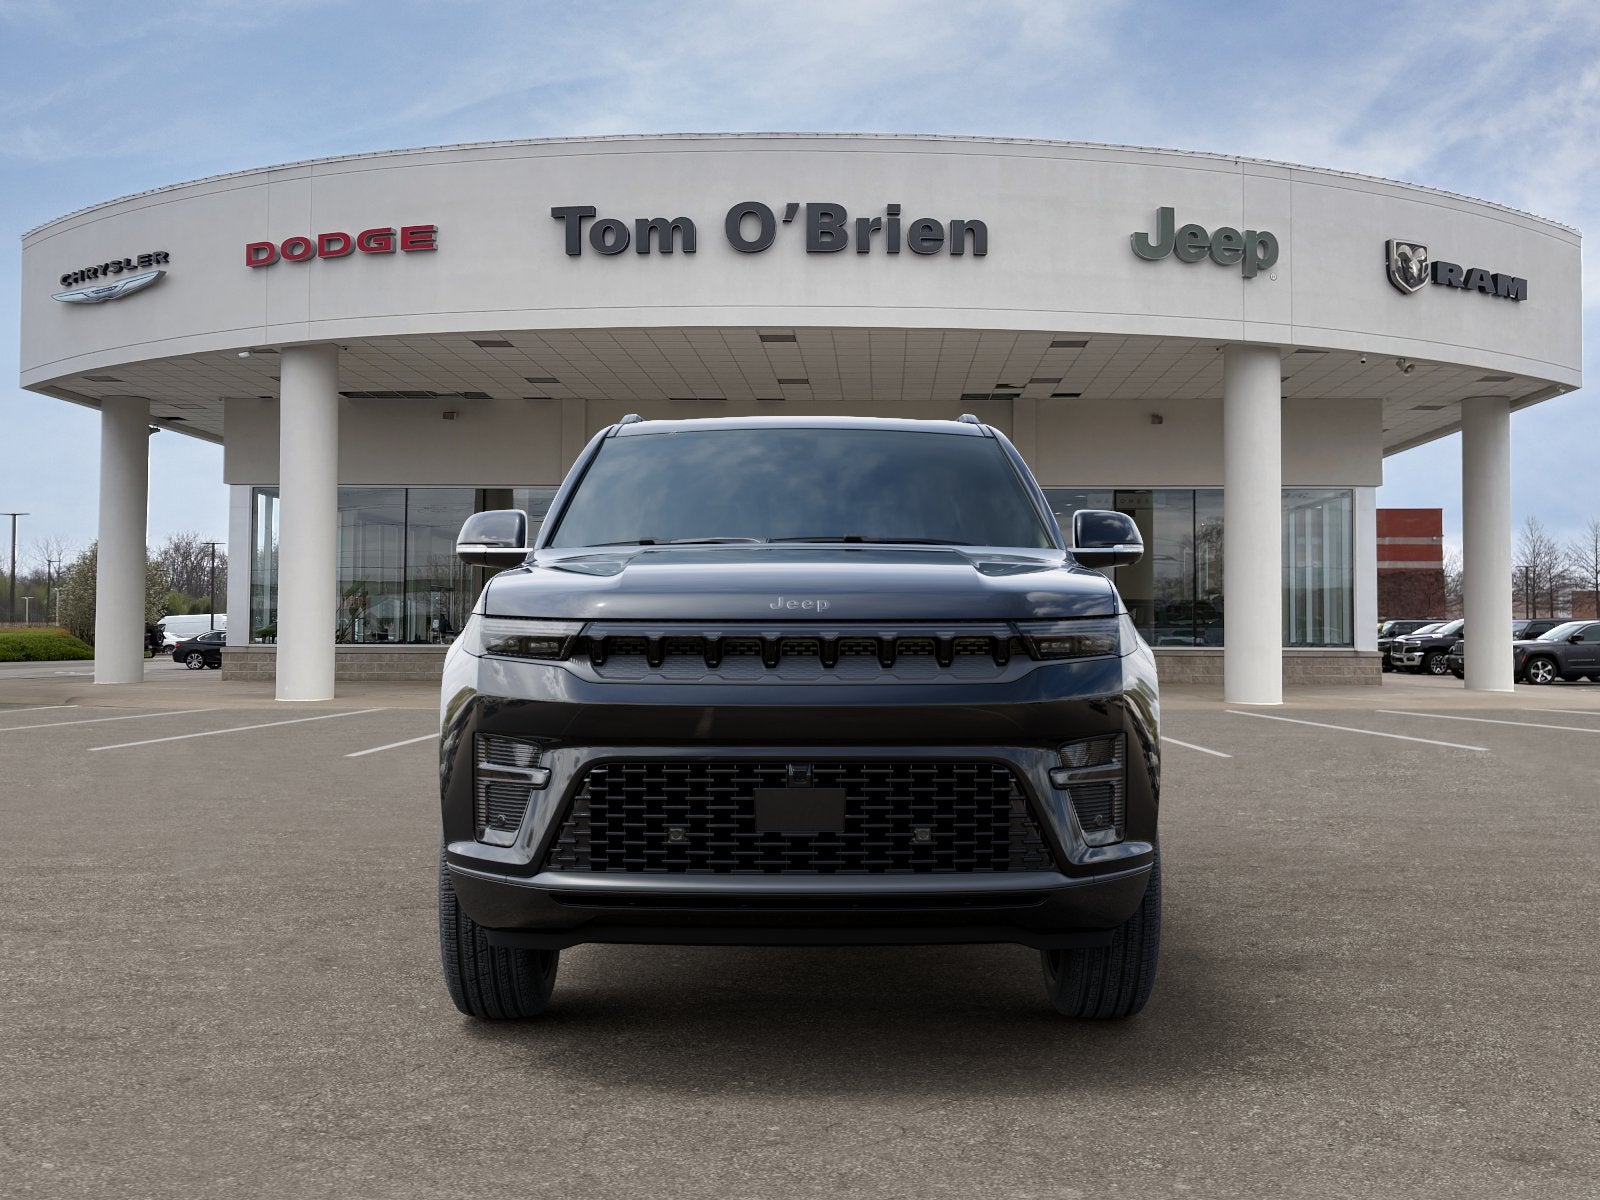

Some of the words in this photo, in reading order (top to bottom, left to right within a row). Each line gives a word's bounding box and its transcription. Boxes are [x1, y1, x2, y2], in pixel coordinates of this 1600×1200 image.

[245, 224, 438, 268] DODGE
[550, 205, 697, 257] Tom
[724, 200, 989, 257] O'Brien
[1130, 206, 1280, 279] Jeep
[60, 250, 170, 287] CHRYSLER
[1430, 260, 1528, 301] RAM
[769, 596, 831, 613] Jeep
